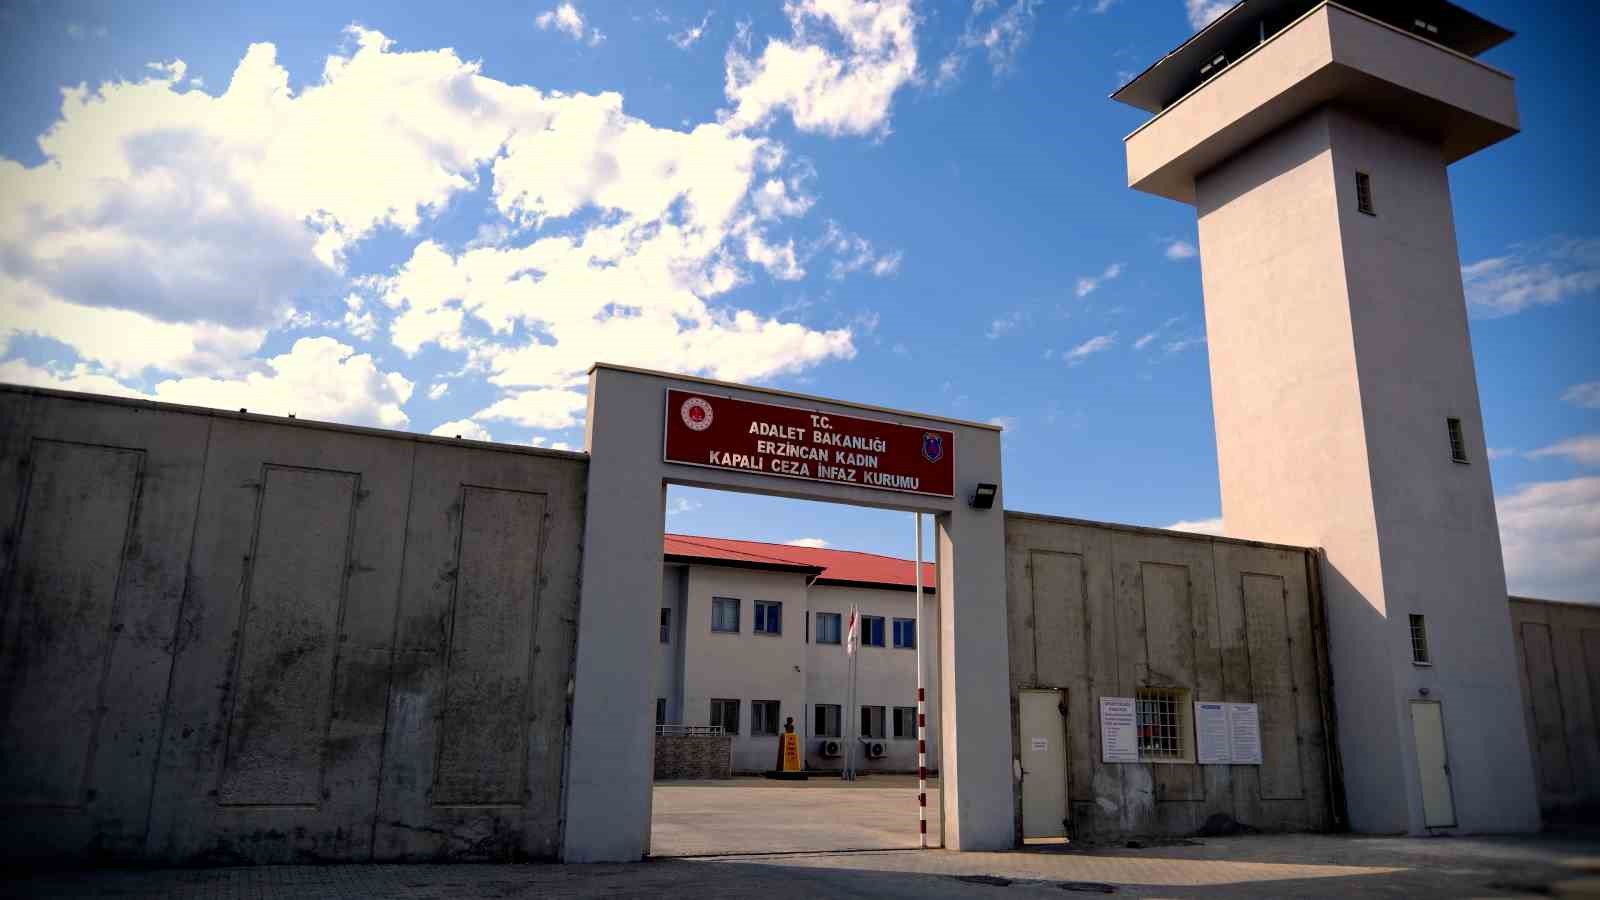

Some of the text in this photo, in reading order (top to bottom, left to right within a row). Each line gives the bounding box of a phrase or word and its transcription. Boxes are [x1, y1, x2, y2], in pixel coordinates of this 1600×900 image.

[749, 421, 886, 453] ADALET BAKANLIĞI
[810, 415, 833, 429] T.C.
[757, 440, 878, 468] ERZİNCAN KADIN
[709, 450, 919, 489] KAPALI CEZA İNFAZ KURUMU
